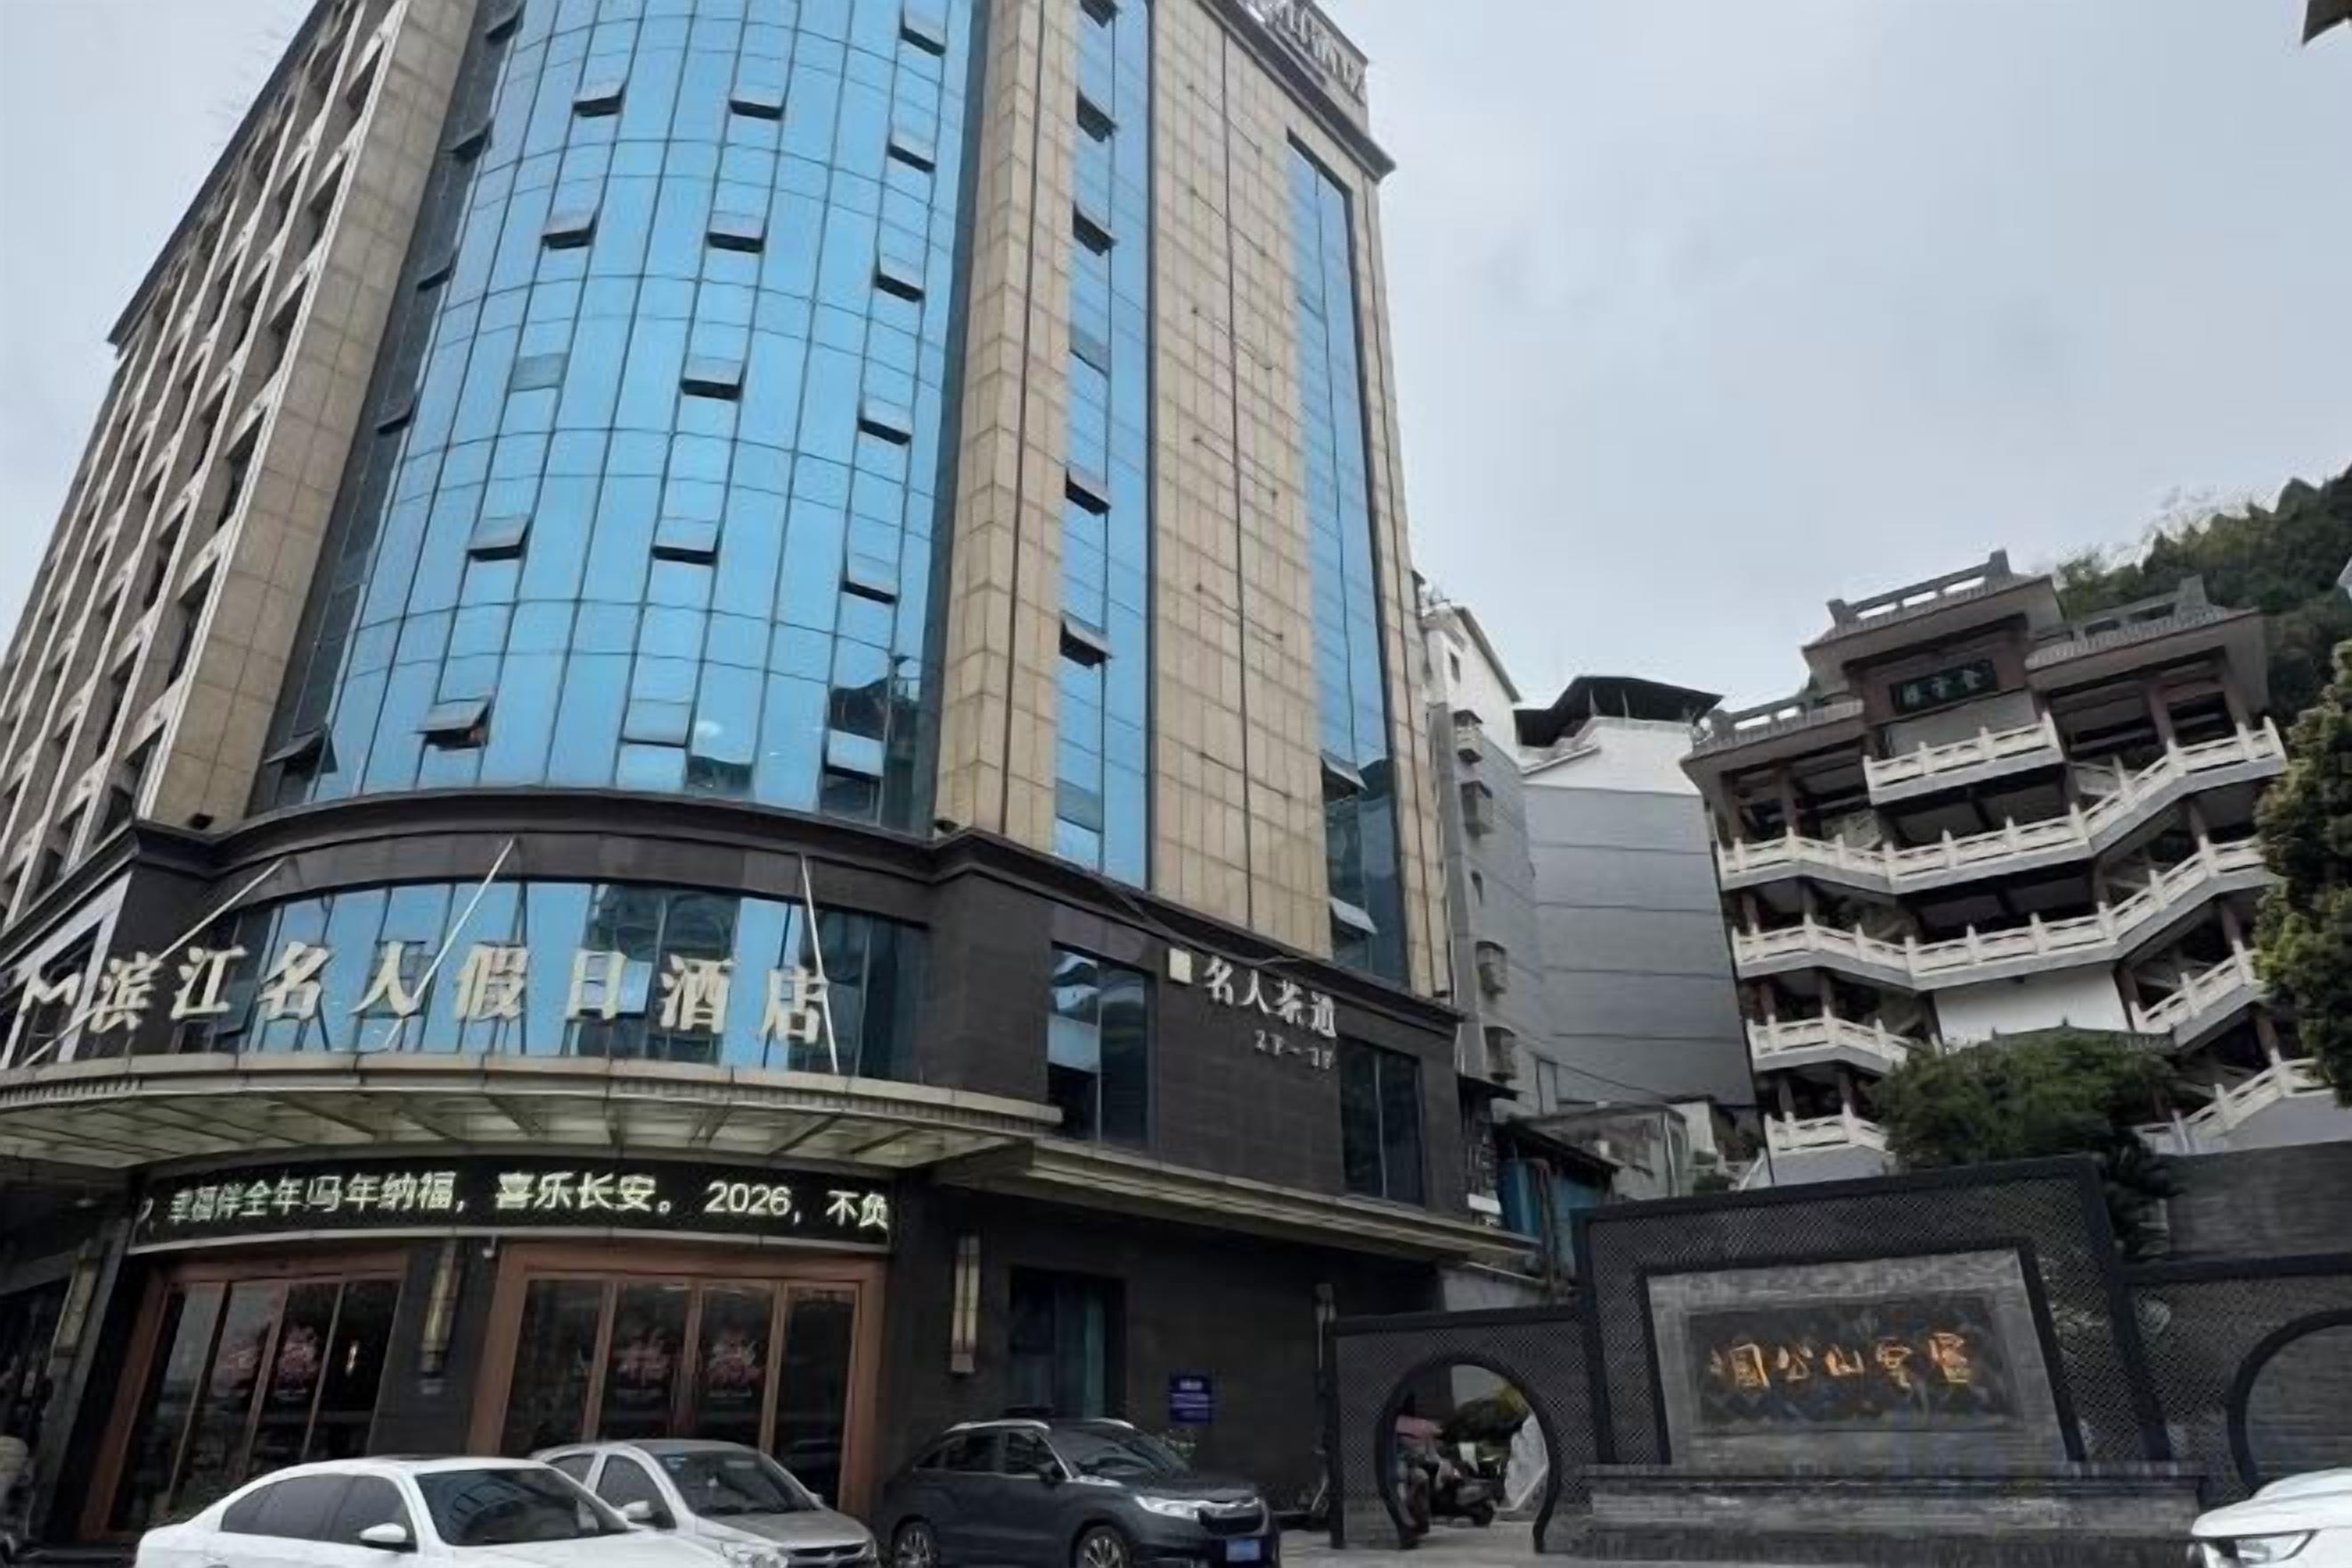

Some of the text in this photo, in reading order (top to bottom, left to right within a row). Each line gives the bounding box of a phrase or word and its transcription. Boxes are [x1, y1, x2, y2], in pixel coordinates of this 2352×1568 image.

[89, 941, 827, 1045] 滨江名人假日酒店
